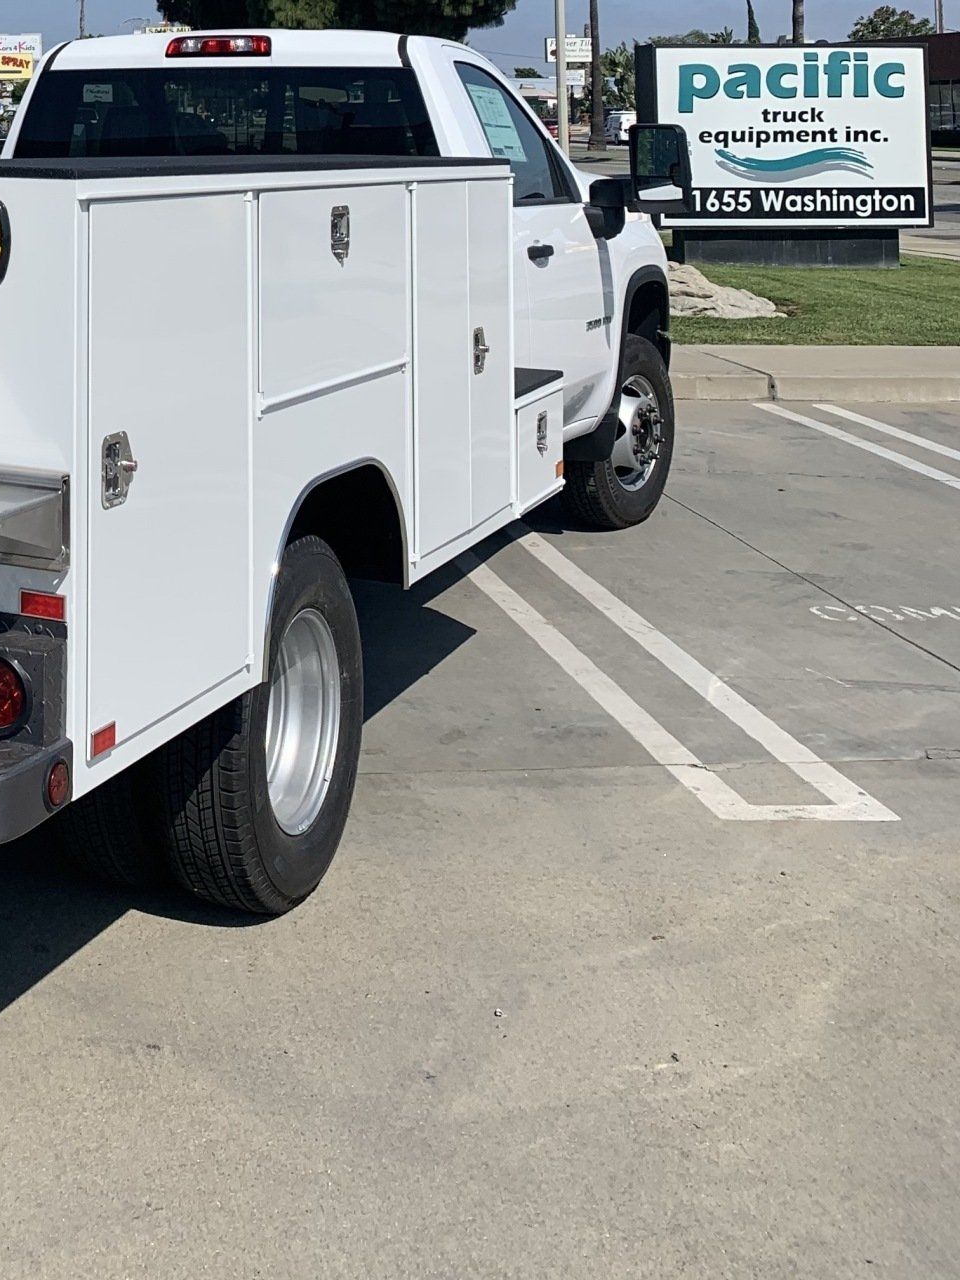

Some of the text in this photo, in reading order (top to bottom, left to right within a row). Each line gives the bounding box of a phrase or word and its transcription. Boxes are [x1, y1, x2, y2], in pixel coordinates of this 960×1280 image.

[18, 41, 35, 53] Kids
[1, 55, 30, 68] SPRAY
[678, 51, 905, 113] pacific
[761, 107, 824, 123] truck
[698, 126, 889, 148] equipment inc.
[691, 189, 915, 217] 1655 Washington
